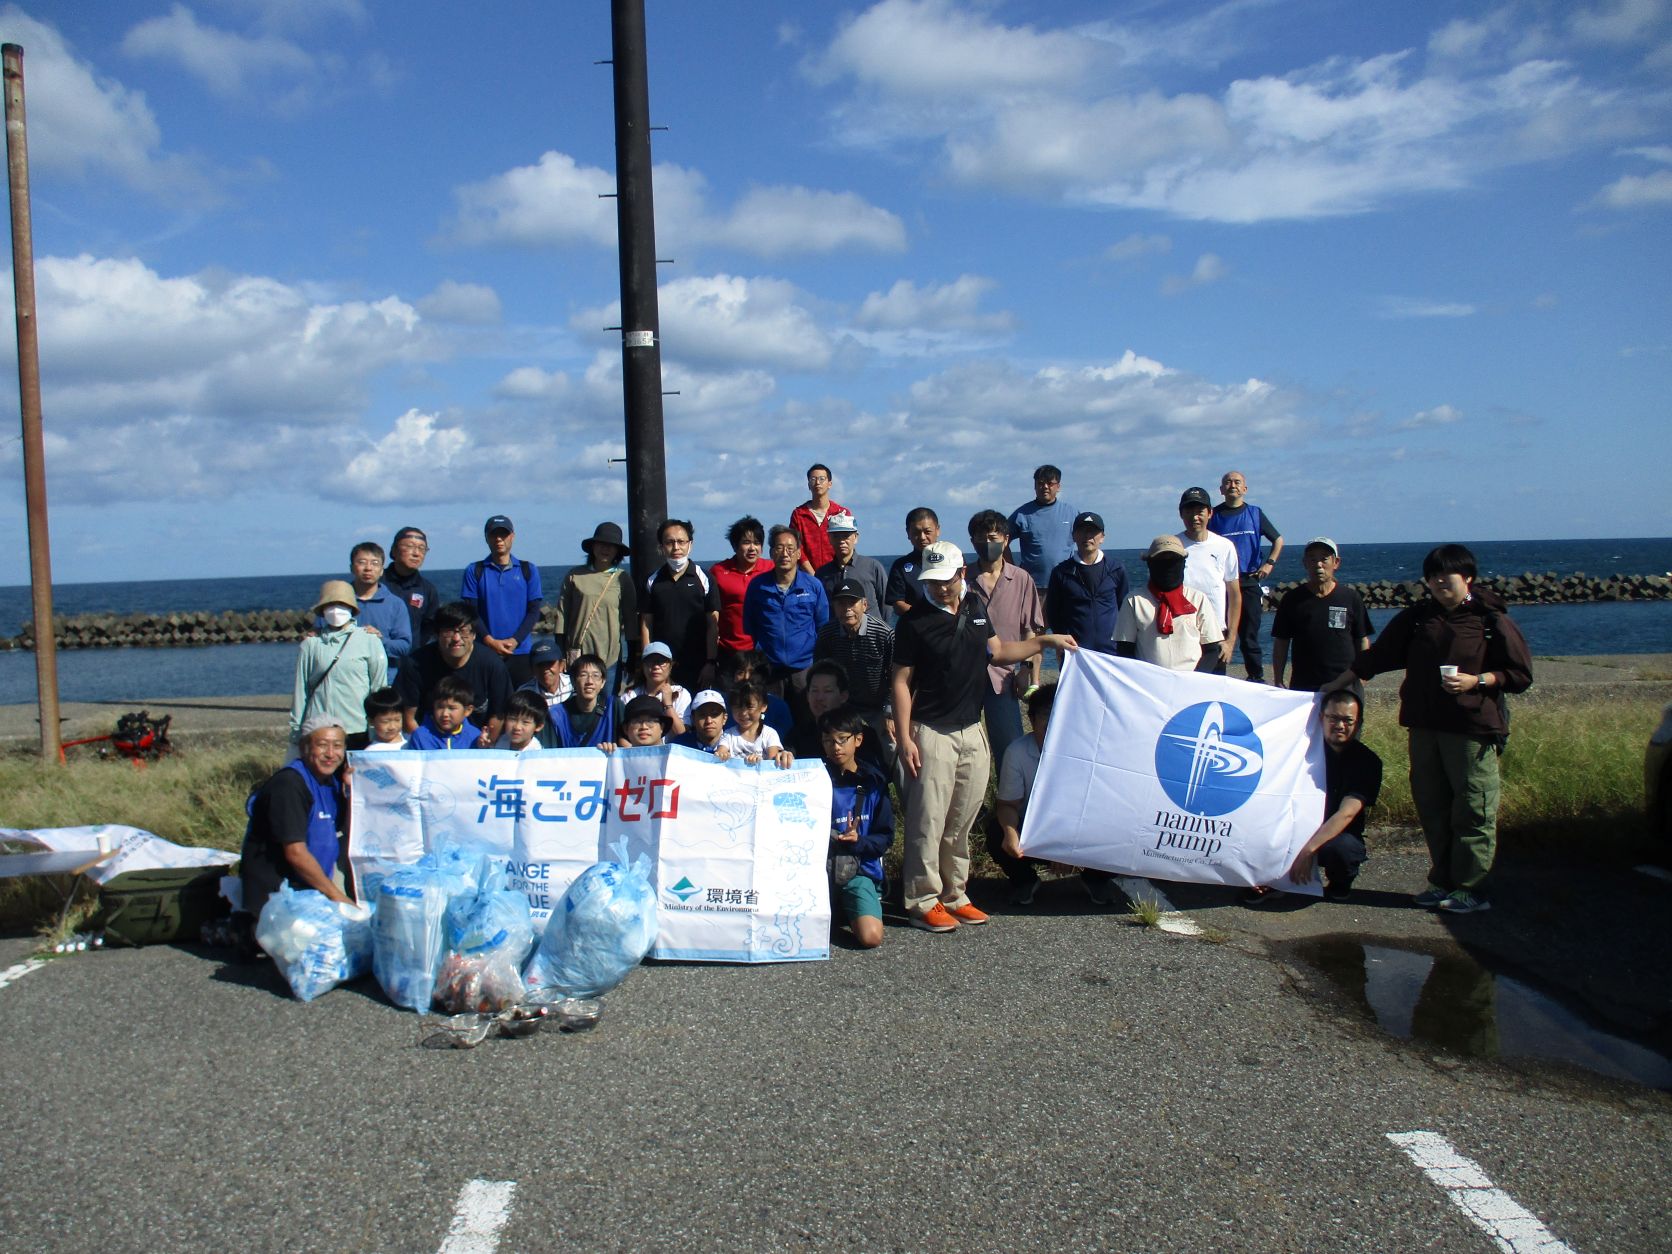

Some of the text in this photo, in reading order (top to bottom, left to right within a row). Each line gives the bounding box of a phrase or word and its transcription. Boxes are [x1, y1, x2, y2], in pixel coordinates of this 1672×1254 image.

[477, 775, 681, 823] 海ごみゼロ
[1153, 810, 1233, 837] naniwa
[1154, 830, 1222, 857] pump
[505, 861, 550, 879] ANGE
[512, 879, 549, 892] FOR THE
[528, 894, 550, 910] UE
[706, 888, 760, 905] 環境省
[664, 904, 693, 912] Ministry
[694, 904, 702, 912] of
